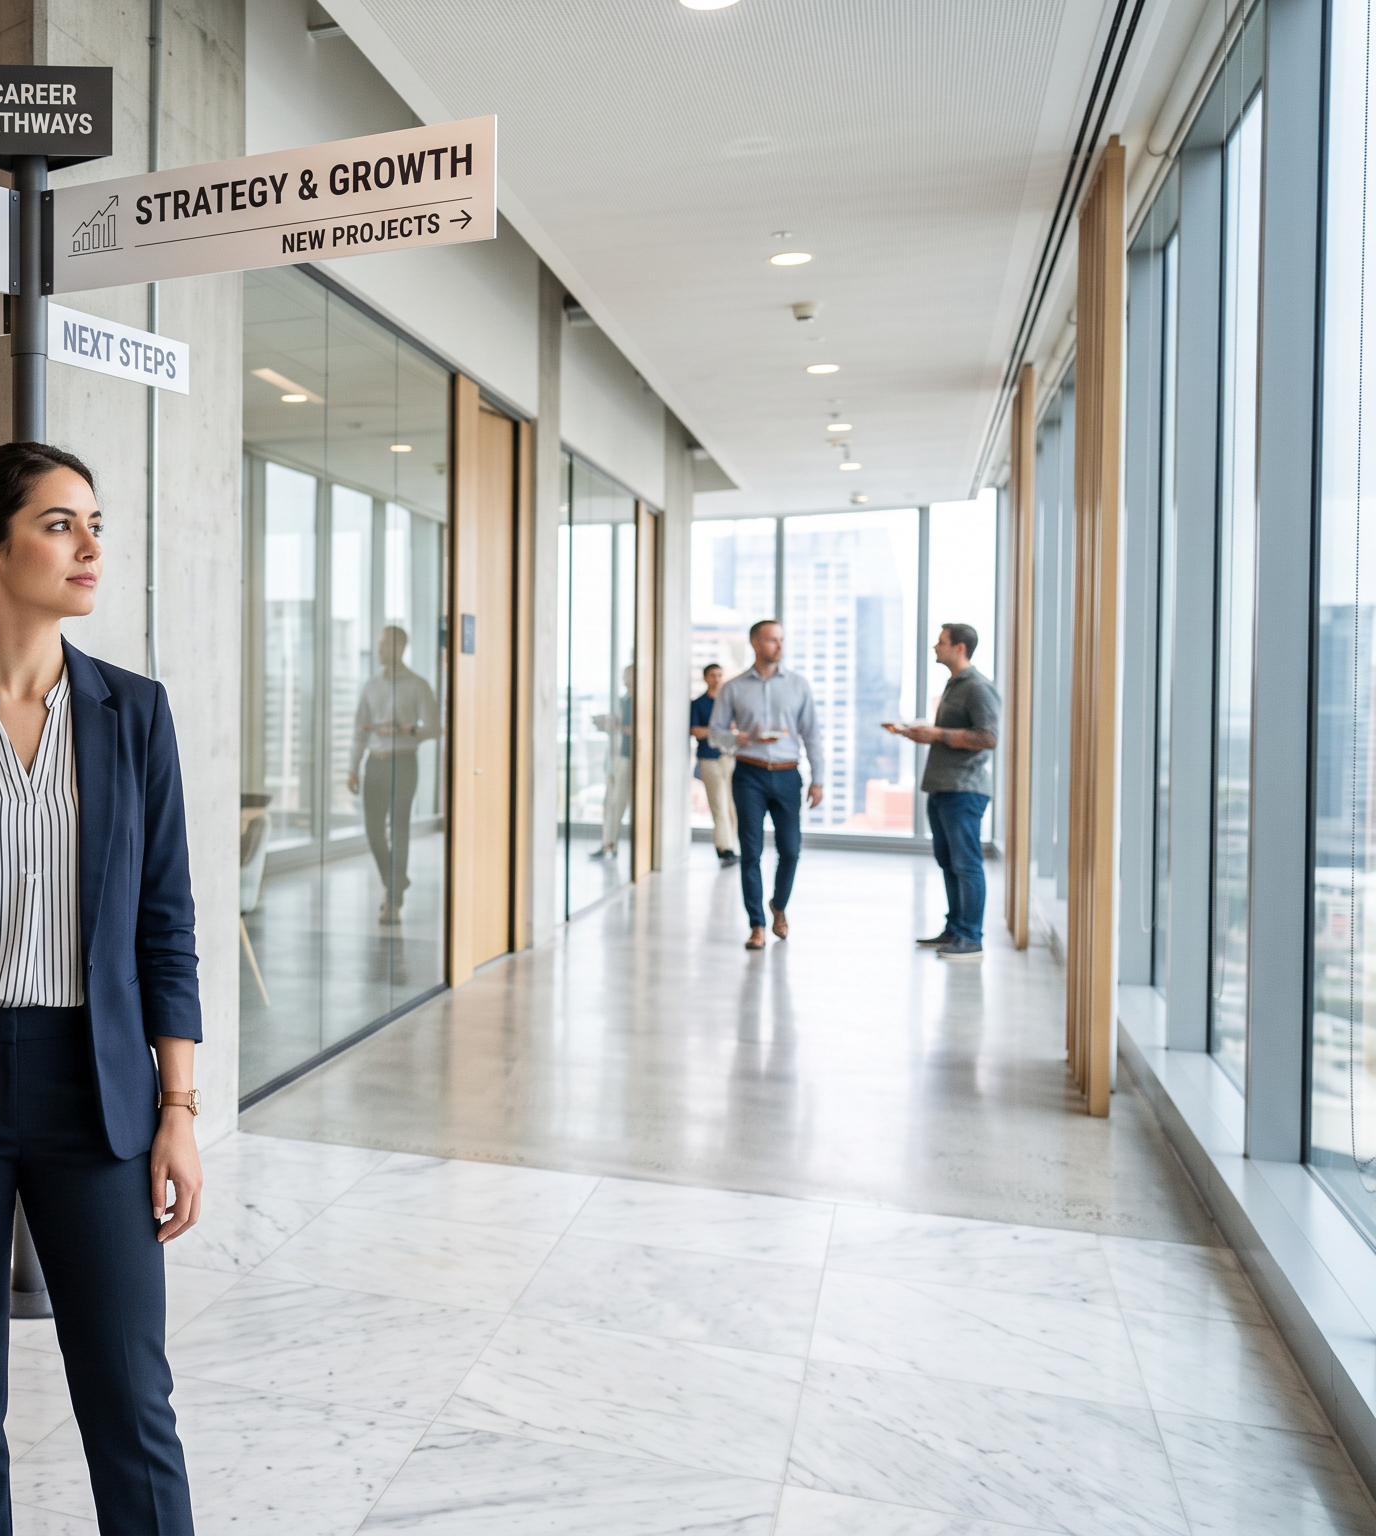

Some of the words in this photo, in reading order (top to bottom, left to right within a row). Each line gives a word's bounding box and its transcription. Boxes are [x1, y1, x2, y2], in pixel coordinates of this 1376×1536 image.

[136, 173, 288, 225] STRATEGY
[299, 169, 318, 200] &
[330, 144, 472, 195] GROWTH
[283, 229, 325, 253] NEW
[333, 214, 439, 247] PROJECTS
[64, 321, 114, 361] NEXT
[120, 338, 175, 379] STEPS
